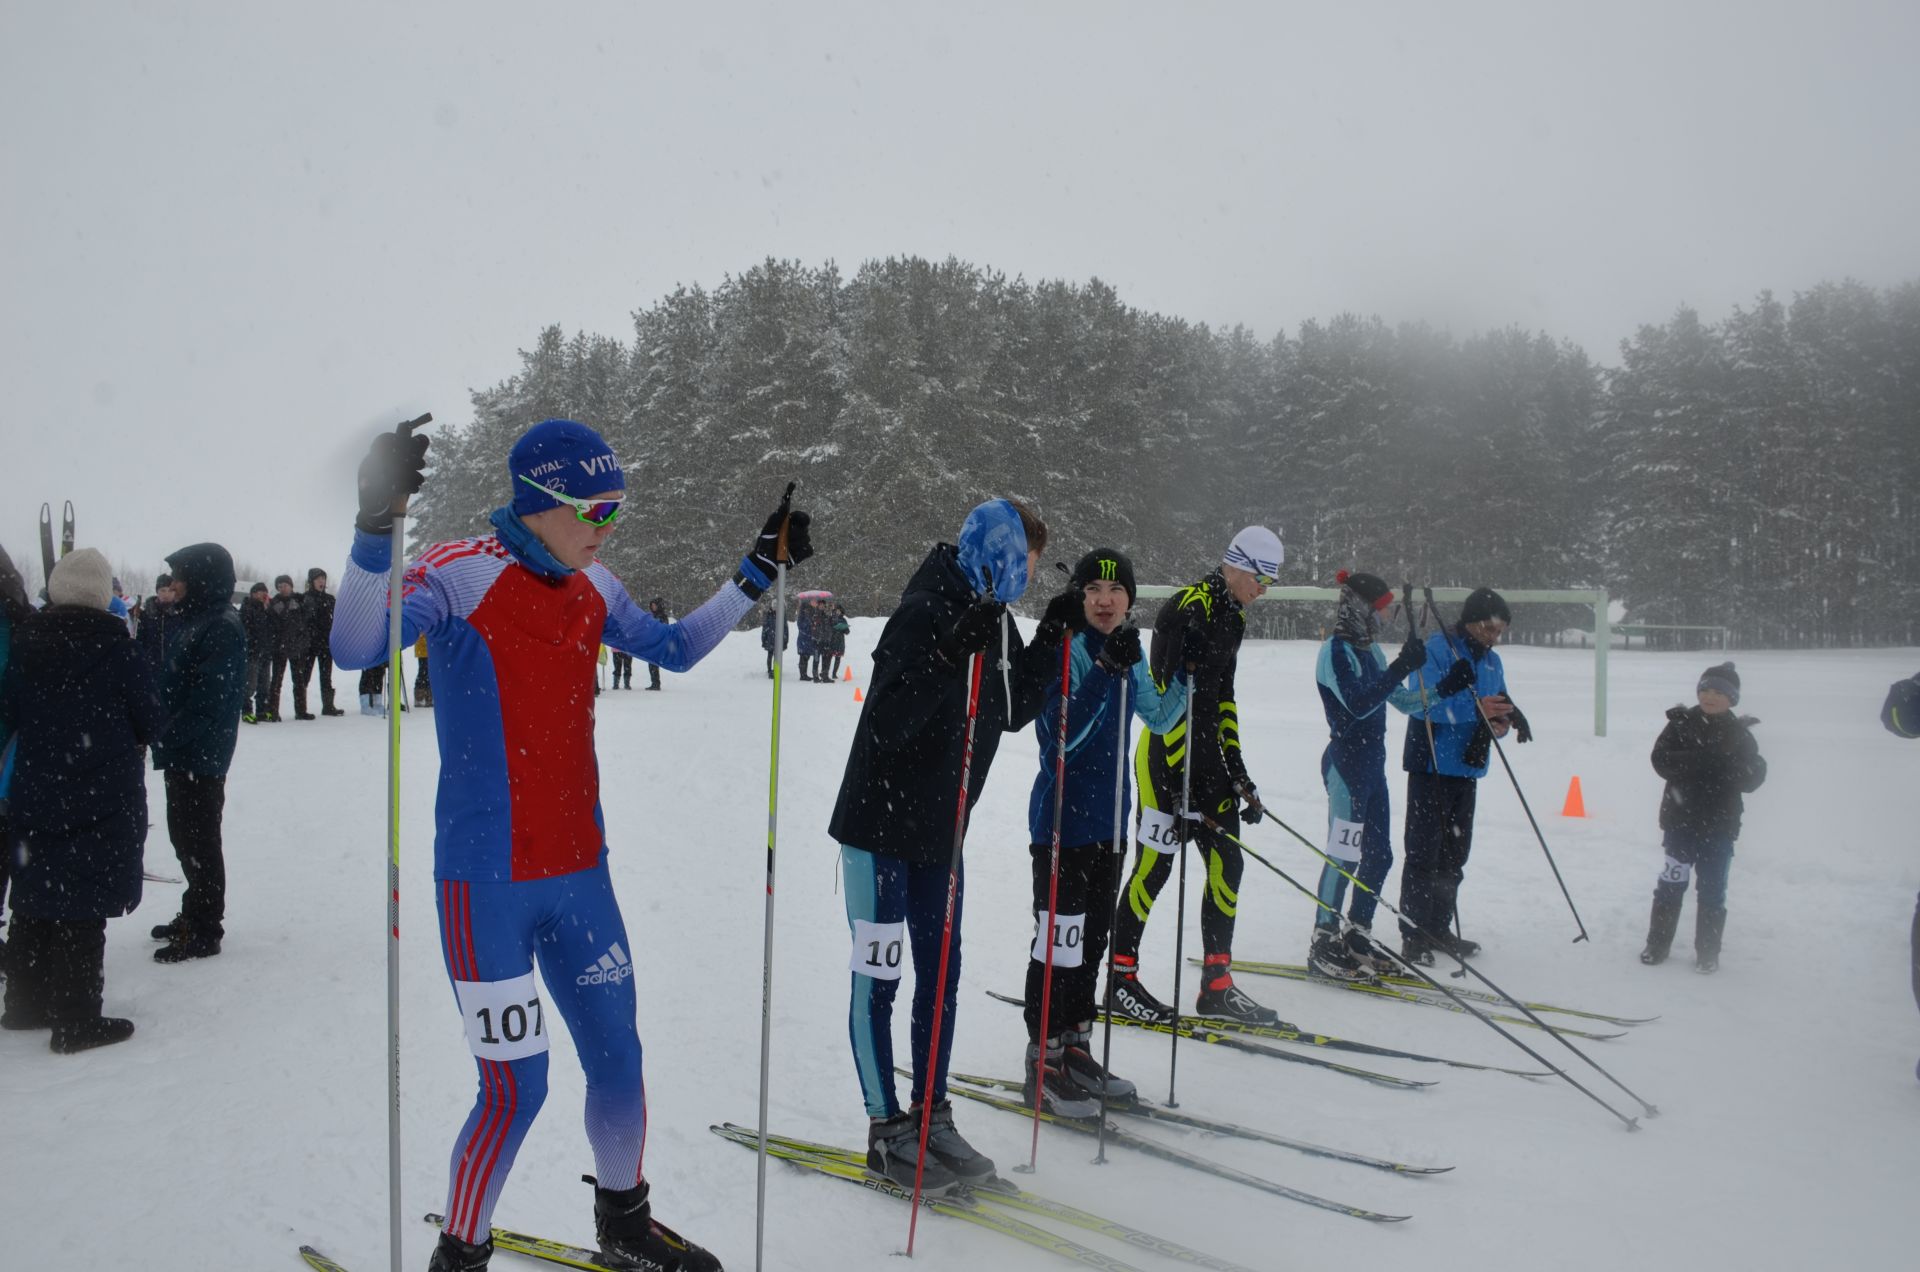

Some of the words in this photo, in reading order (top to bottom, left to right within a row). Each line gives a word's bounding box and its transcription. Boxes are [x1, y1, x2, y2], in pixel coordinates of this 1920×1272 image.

[530, 460, 563, 478] VITAL
[1148, 824, 1181, 846] 10
[576, 963, 632, 986] adidas
[476, 997, 543, 1044] 107
